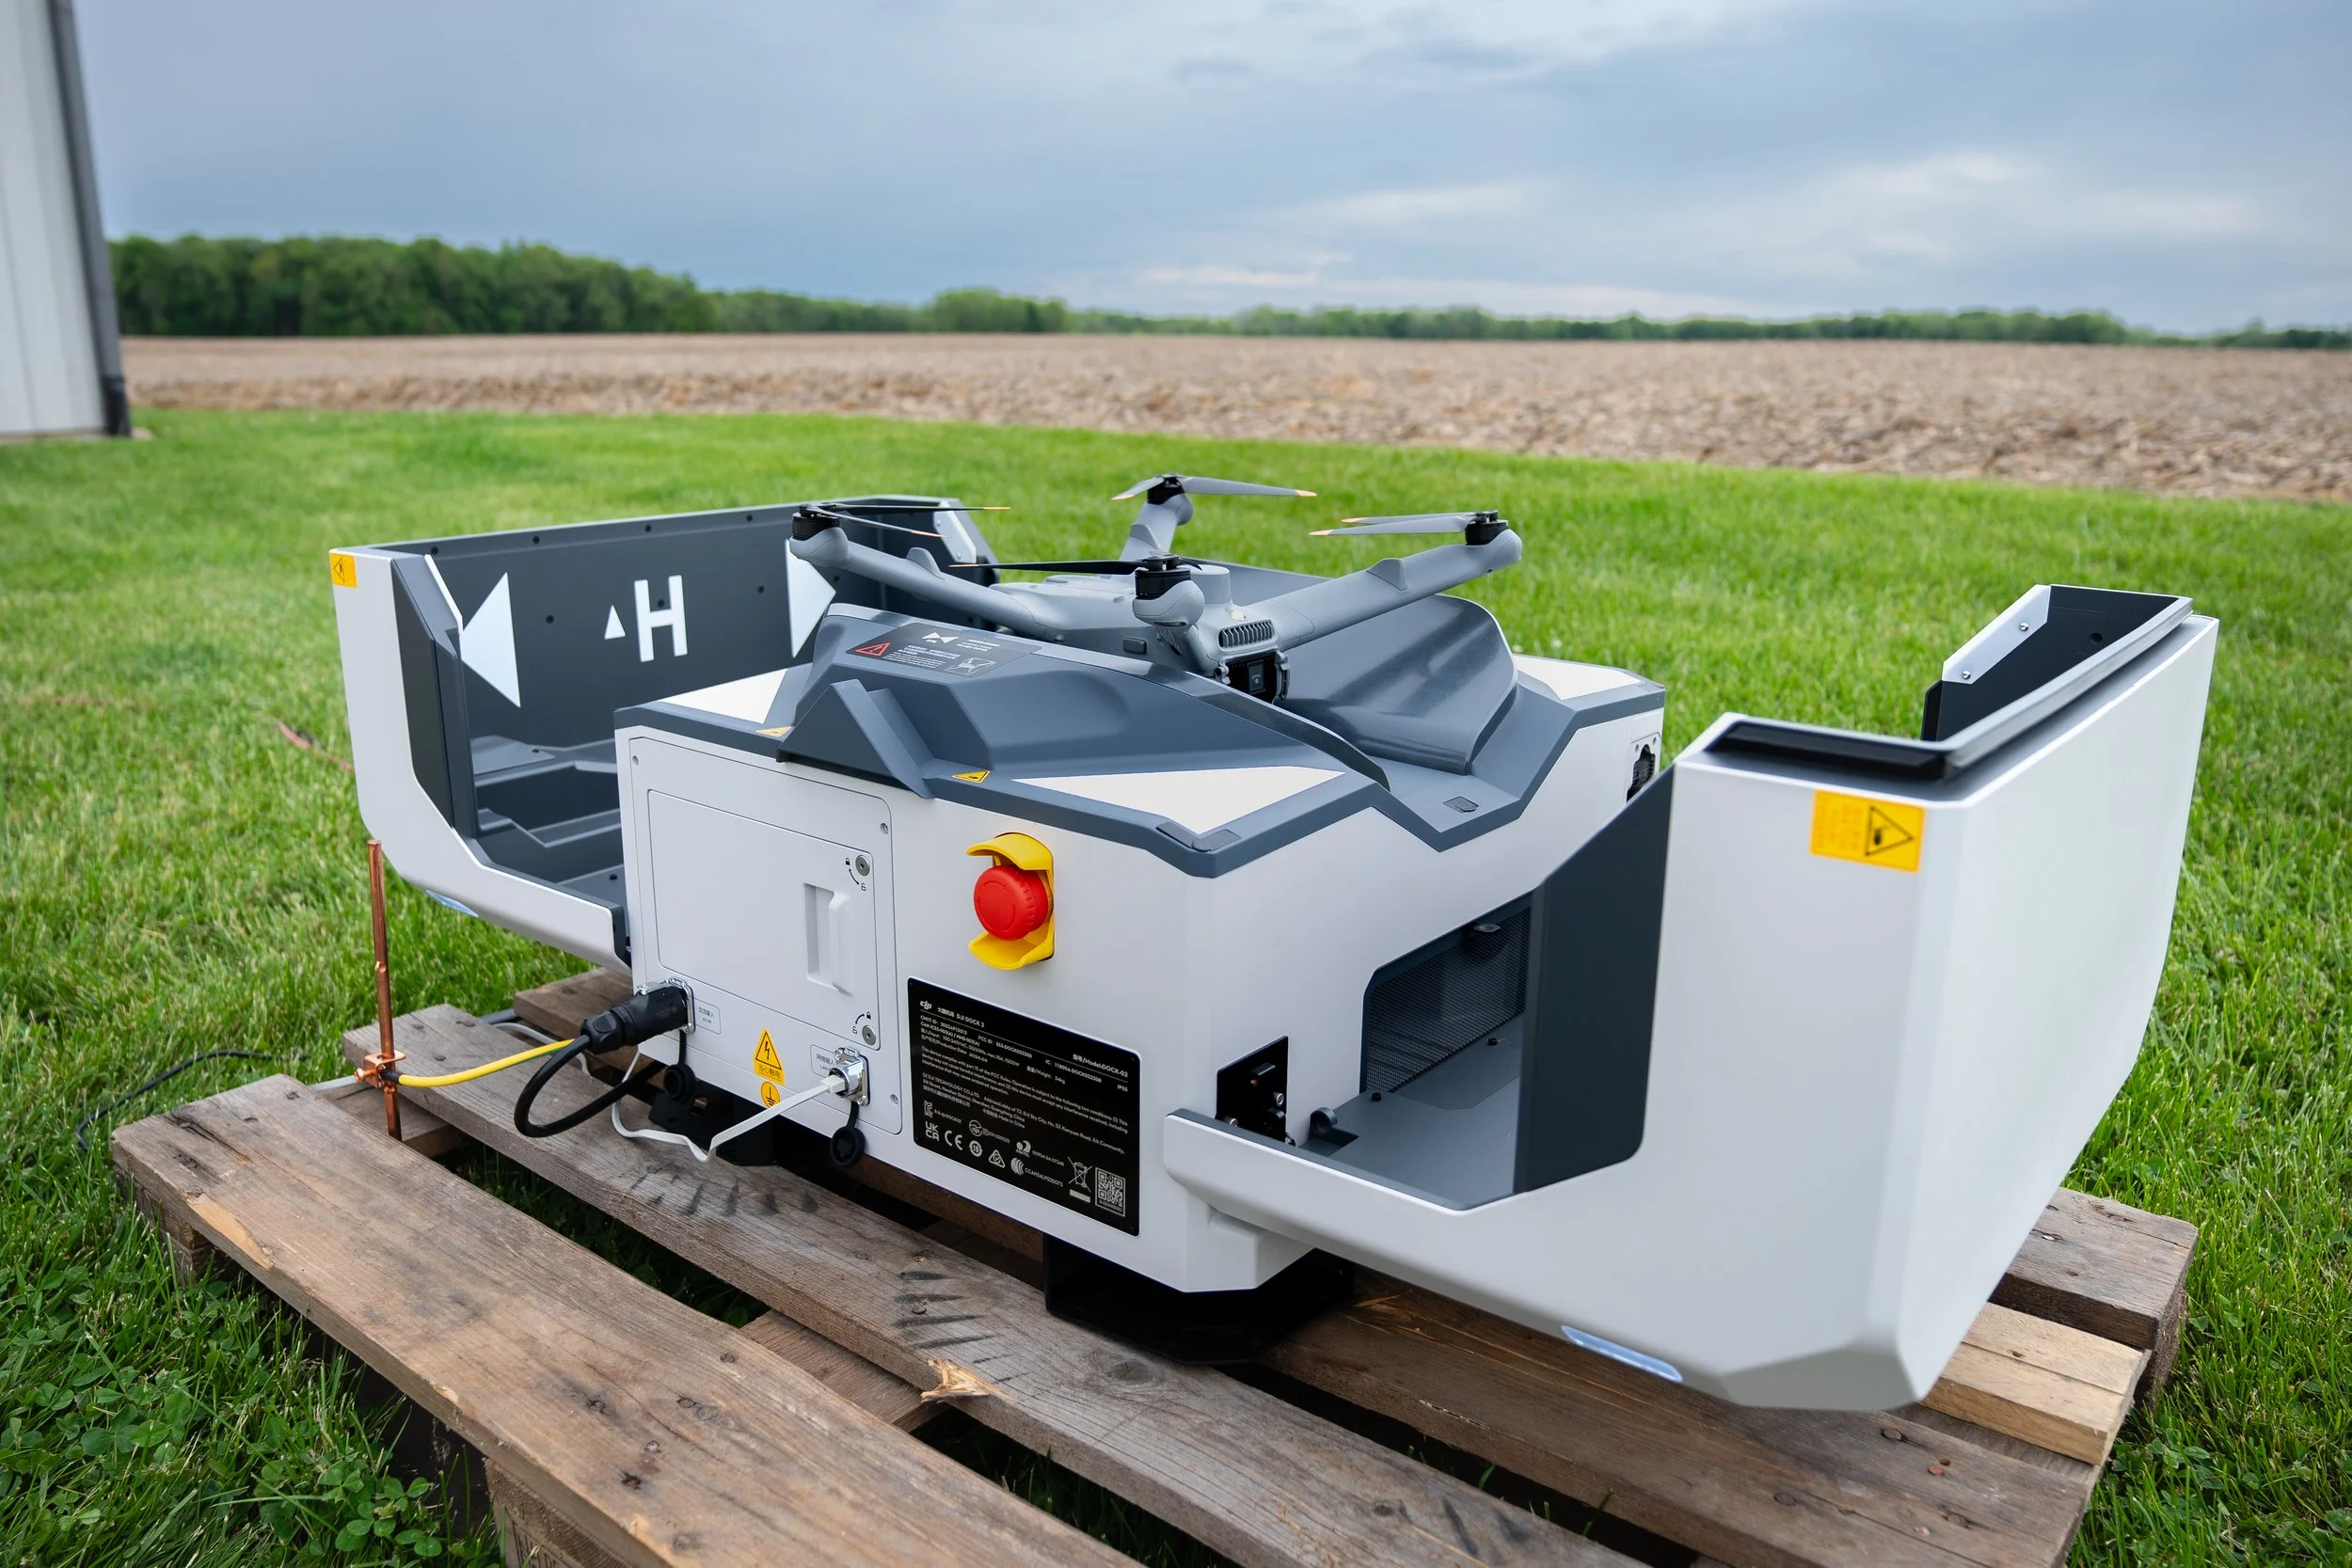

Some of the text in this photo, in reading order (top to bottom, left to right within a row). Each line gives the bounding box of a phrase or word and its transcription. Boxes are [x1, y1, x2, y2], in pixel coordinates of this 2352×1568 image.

[634, 575, 688, 662] H
[965, 1017, 980, 1026] DOCK
[945, 1131, 962, 1150] CE
